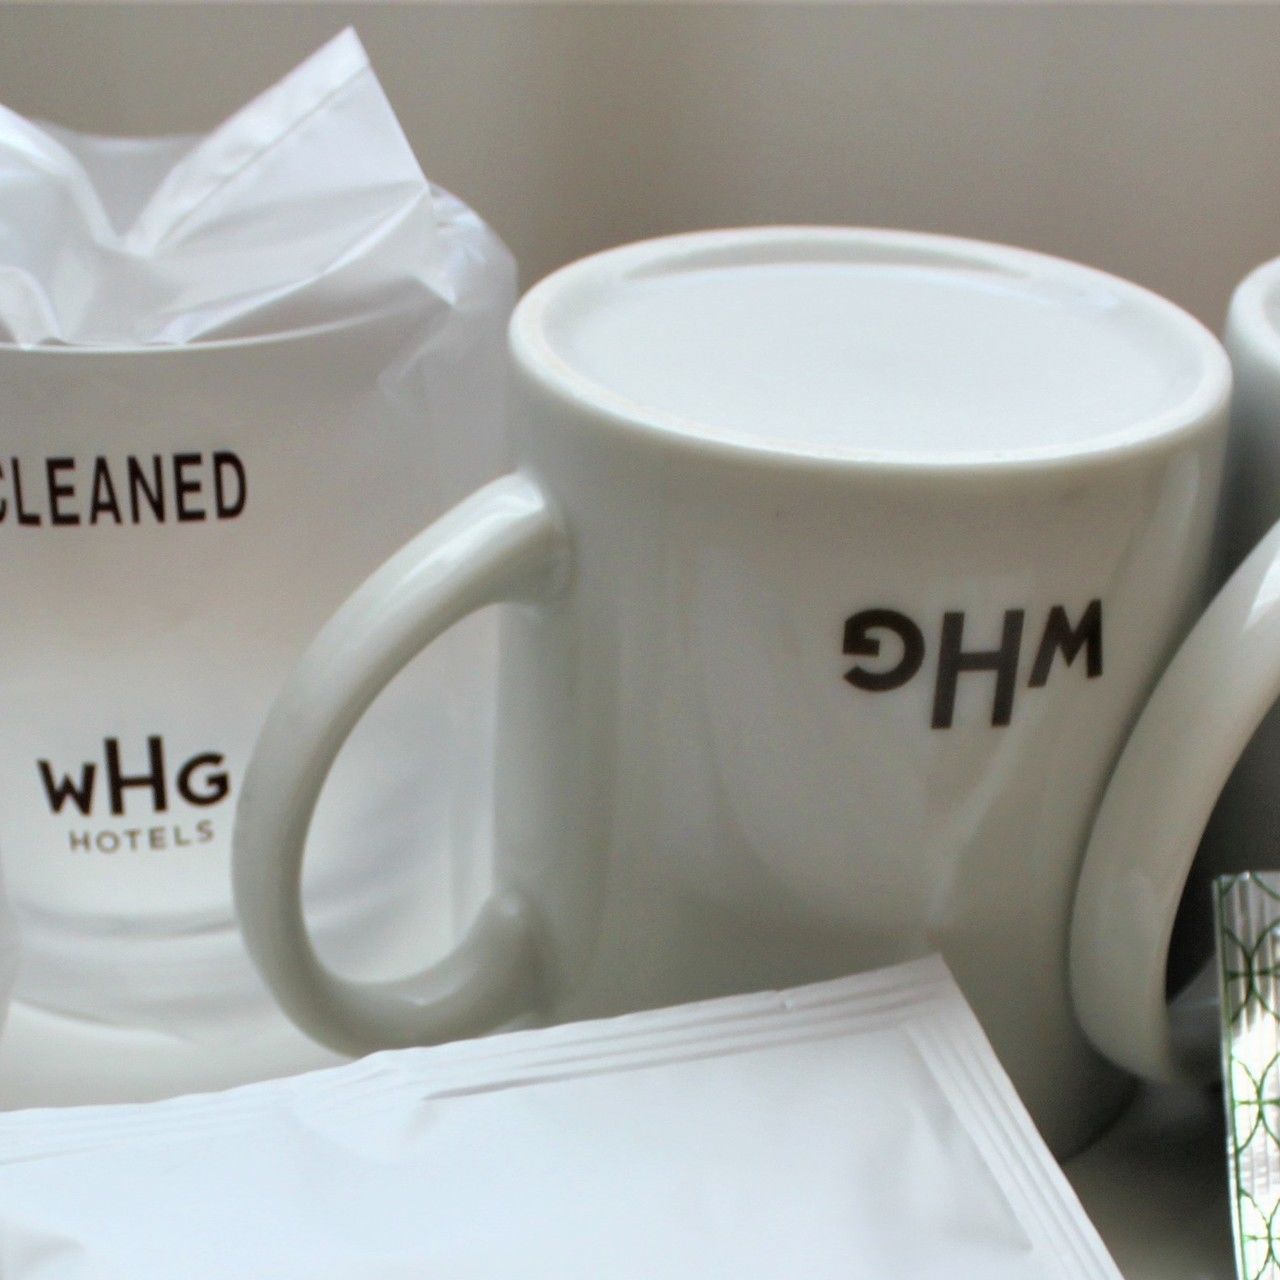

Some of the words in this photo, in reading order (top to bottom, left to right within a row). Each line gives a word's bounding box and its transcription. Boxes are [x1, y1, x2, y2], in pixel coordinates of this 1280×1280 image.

[841, 598, 1103, 730] WHG
[36, 735, 230, 817] WHG
[68, 820, 215, 854] HOTELS
